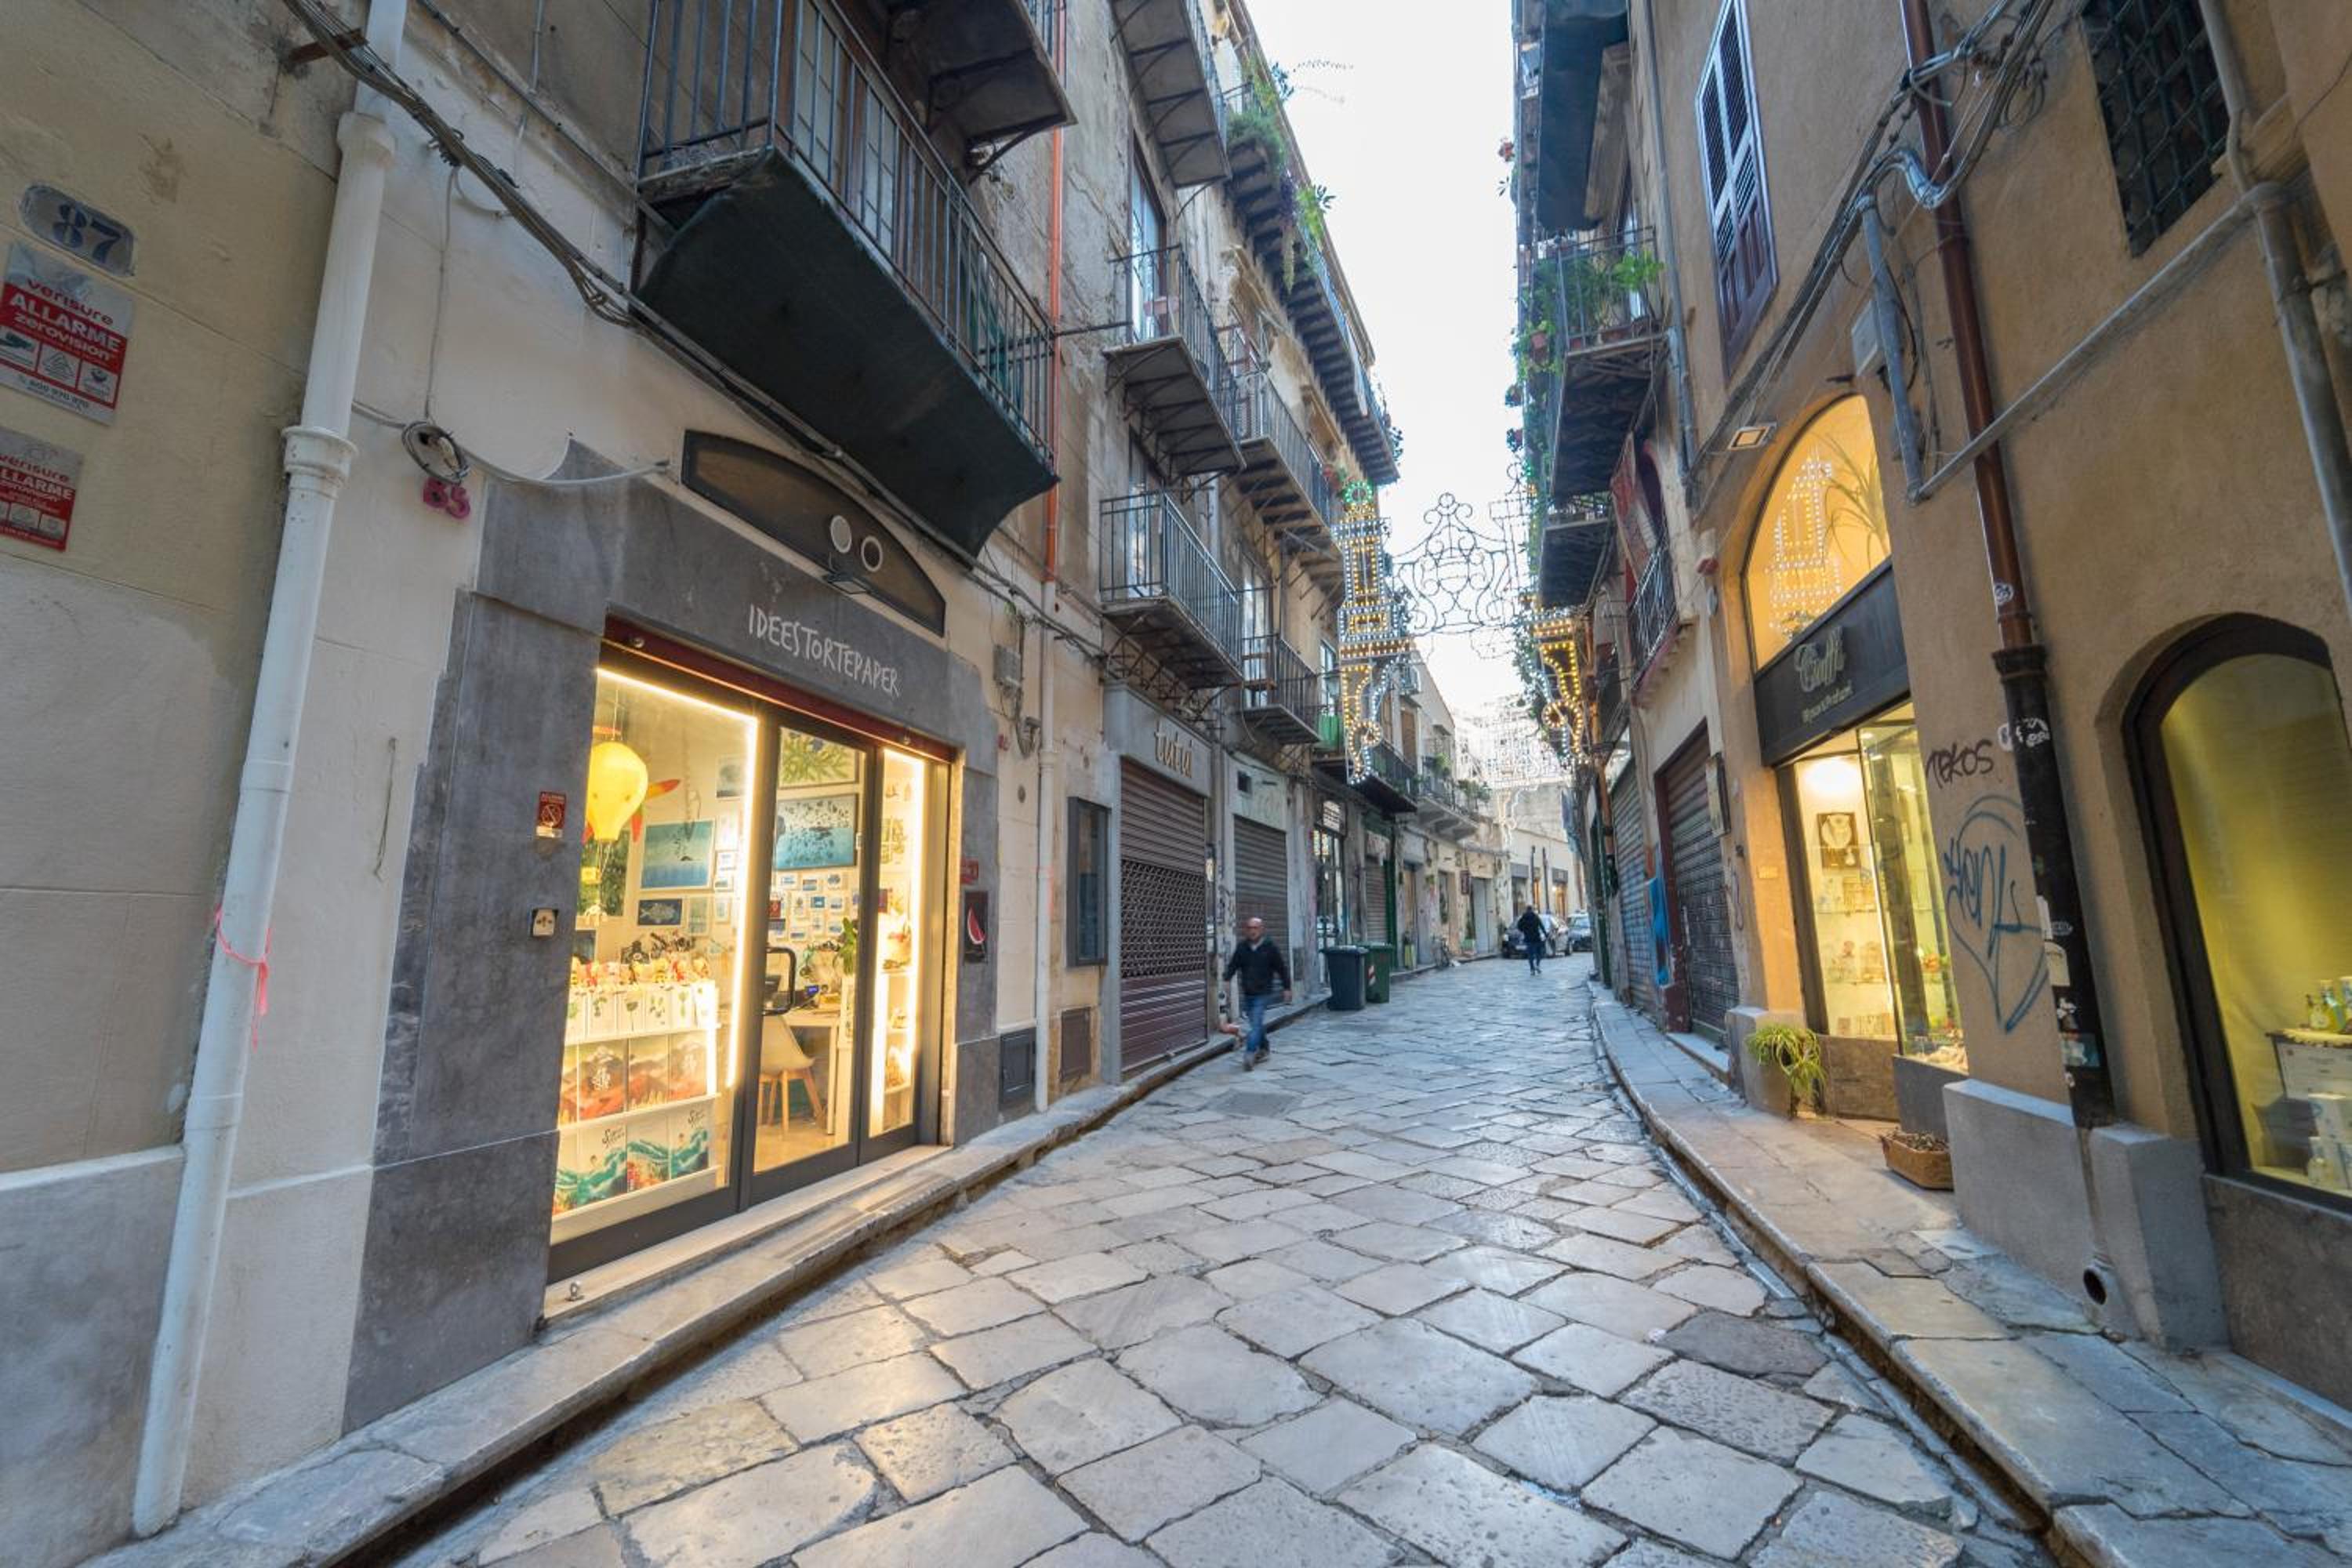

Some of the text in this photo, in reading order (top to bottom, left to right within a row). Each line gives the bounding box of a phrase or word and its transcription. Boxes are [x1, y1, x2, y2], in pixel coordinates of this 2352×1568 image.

[10, 292, 121, 352] ALLARME
[27, 277, 114, 325] verisure
[0, 466, 74, 501] LLARME
